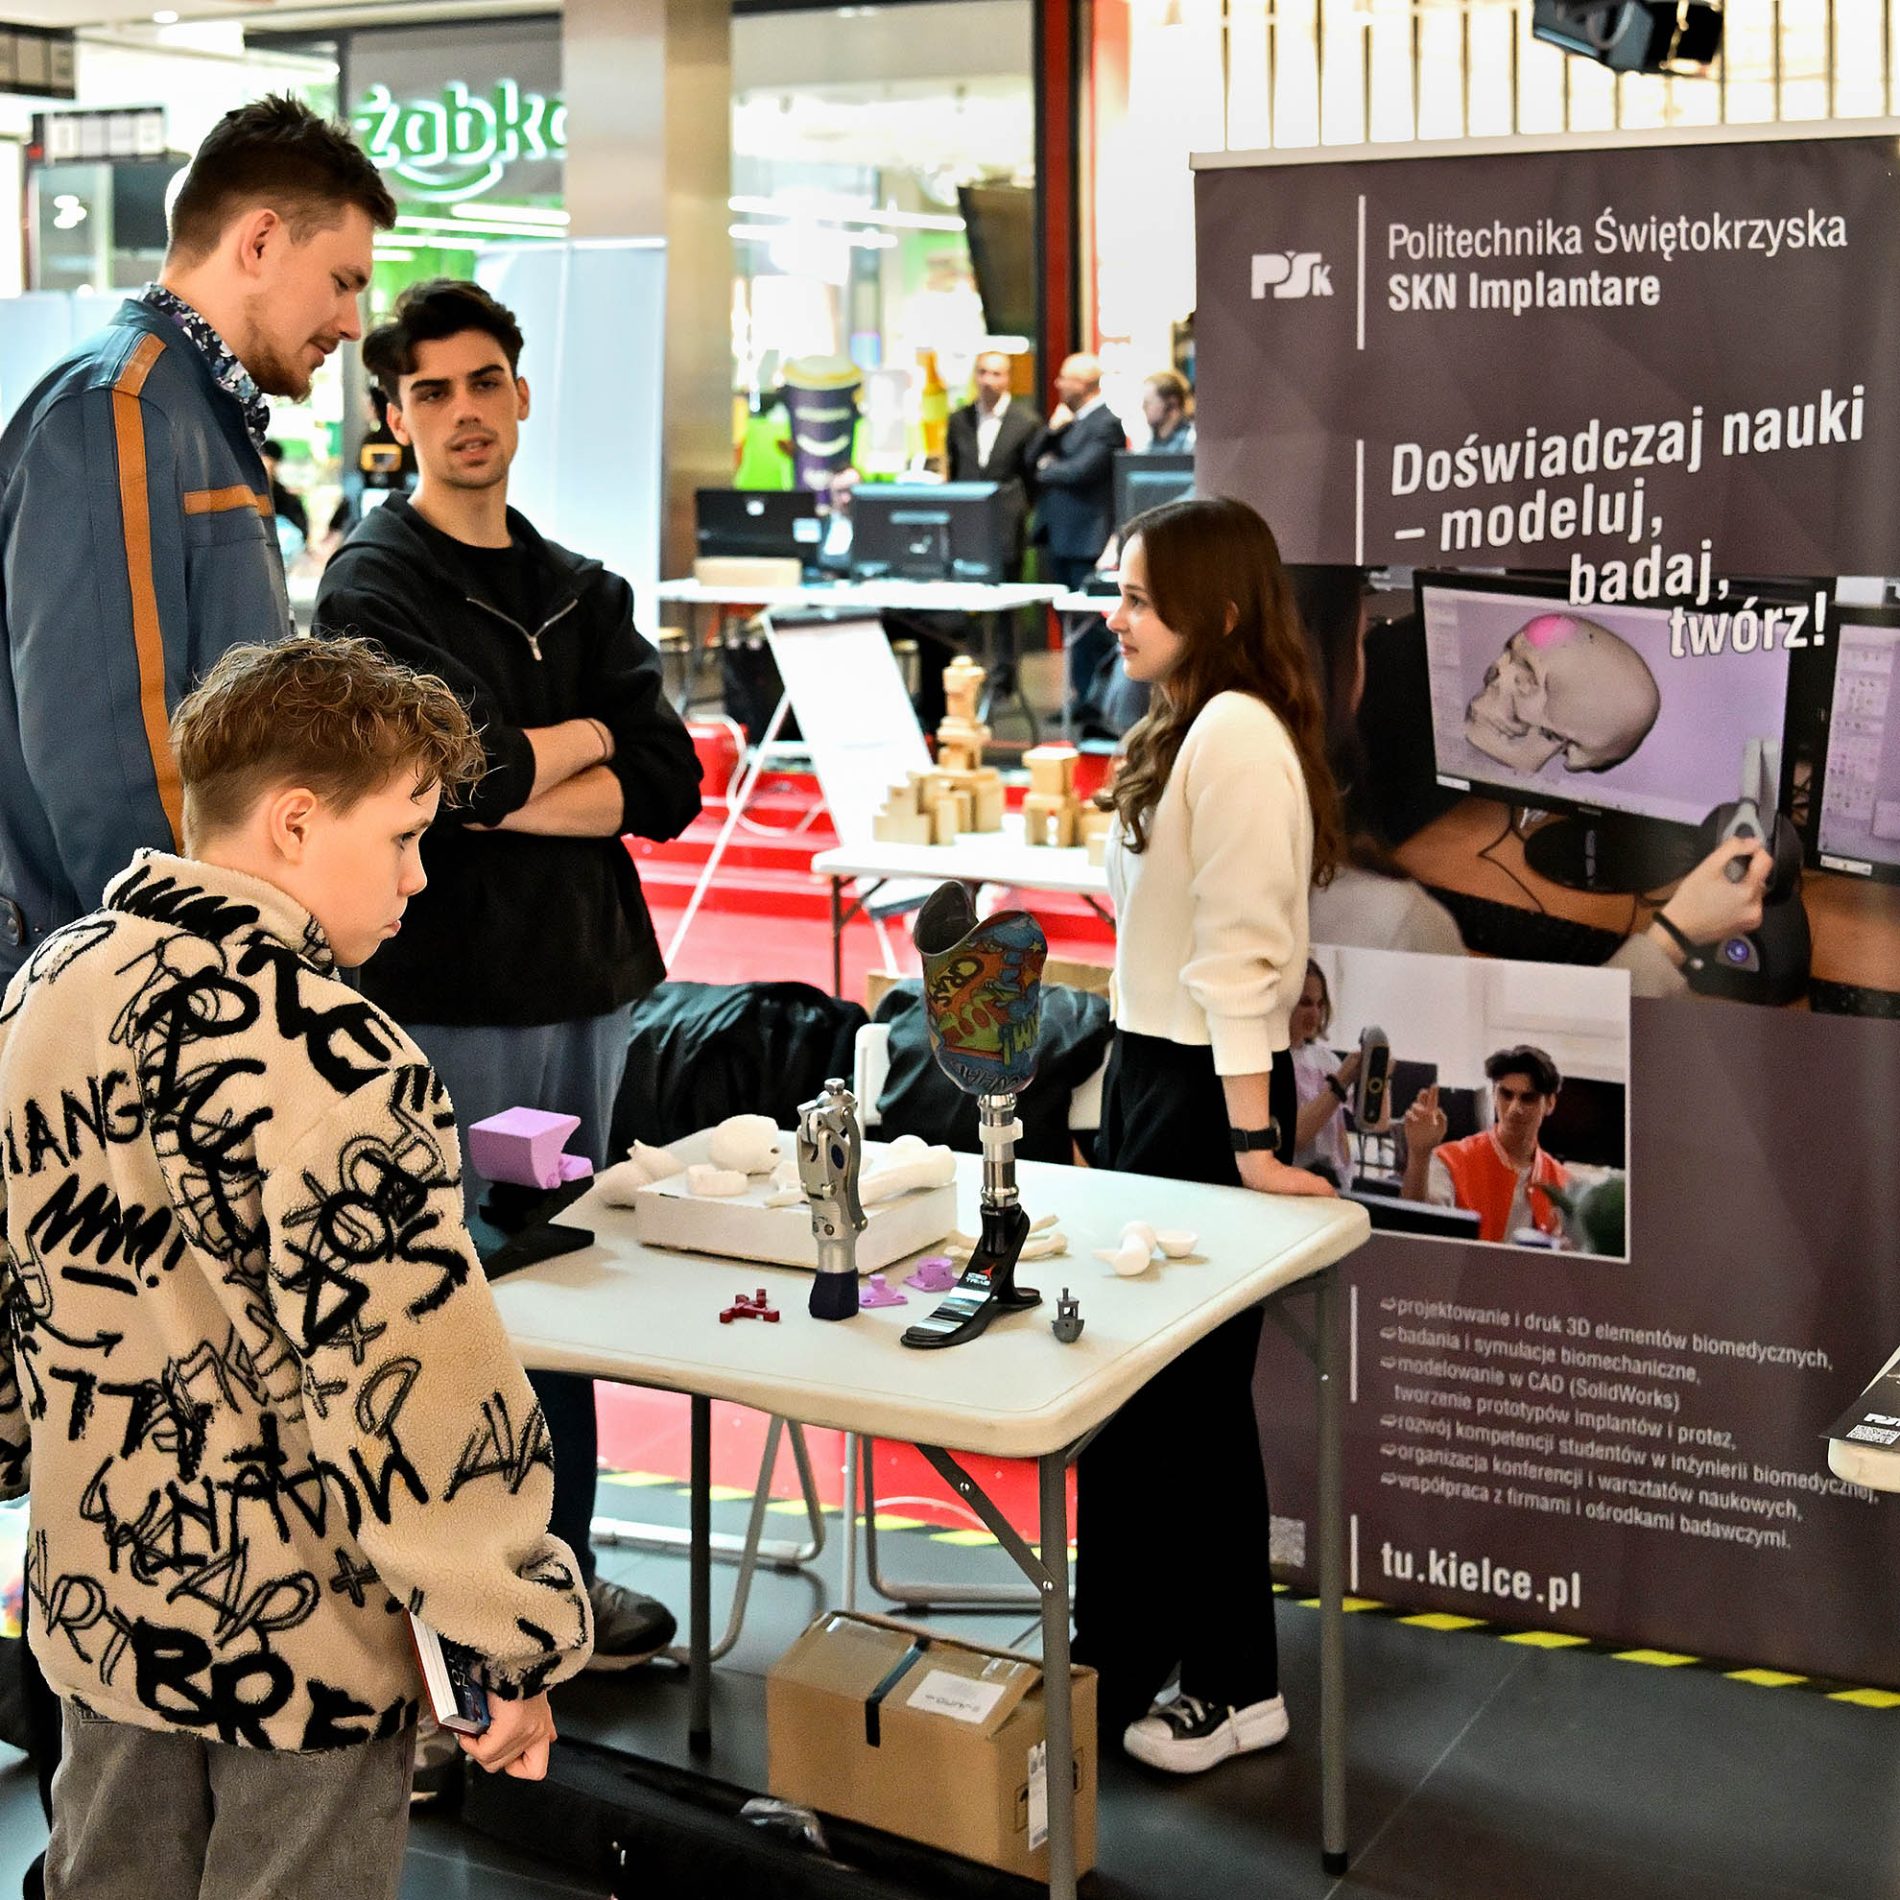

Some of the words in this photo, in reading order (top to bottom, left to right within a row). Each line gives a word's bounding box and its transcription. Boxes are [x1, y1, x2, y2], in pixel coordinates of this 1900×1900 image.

[1388, 217, 1584, 260] Politechnika
[1594, 206, 1848, 261] Świętokrzyska
[1388, 271, 1457, 312] SKN
[1469, 269, 1660, 317] Implantare
[1391, 405, 1704, 496] Doświadczaj
[1720, 385, 1865, 457] nauki
[1439, 477, 1663, 552] modeluj,
[1569, 538, 1730, 607] badaj,
[1669, 591, 1828, 659] twórz!
[1398, 1299, 1510, 1327] projektowanie
[1514, 1311, 1521, 1327] i
[1524, 1313, 1562, 1333] druk
[1566, 1316, 1591, 1337] 3D
[1595, 1322, 1688, 1350] elementów
[1398, 1326, 1460, 1349] badania
[1464, 1333, 1471, 1349] i
[1474, 1337, 1556, 1365] symulacje
[1394, 1384, 1472, 1411] tworzenie
[1477, 1398, 1571, 1425] prototypów
[1575, 1408, 1663, 1437] implantów
[1667, 1421, 1673, 1438] i
[1398, 1355, 1505, 1387] modelowanie
[1509, 1373, 1523, 1388] w
[1527, 1370, 1565, 1394] CAD
[1569, 1376, 1681, 1414] (SolidWorks)
[1398, 1415, 1451, 1441] rozwój
[1455, 1421, 1555, 1455] kompetencji
[1558, 1438, 1647, 1466] studentów
[1651, 1452, 1666, 1469] w
[1671, 1451, 1748, 1480] inżynierii
[1398, 1444, 1488, 1474] organizacja
[1493, 1454, 1583, 1489] konferencji
[1587, 1470, 1593, 1488] i
[1598, 1474, 1694, 1503] warsztatów
[1399, 1473, 1489, 1502] współpraca
[1494, 1488, 1502, 1504] z
[1507, 1487, 1571, 1515] firmami
[1575, 1499, 1581, 1516] i
[1585, 1500, 1675, 1531] ośrodkami
[1380, 1542, 1582, 1613] tu.kielce.pl
